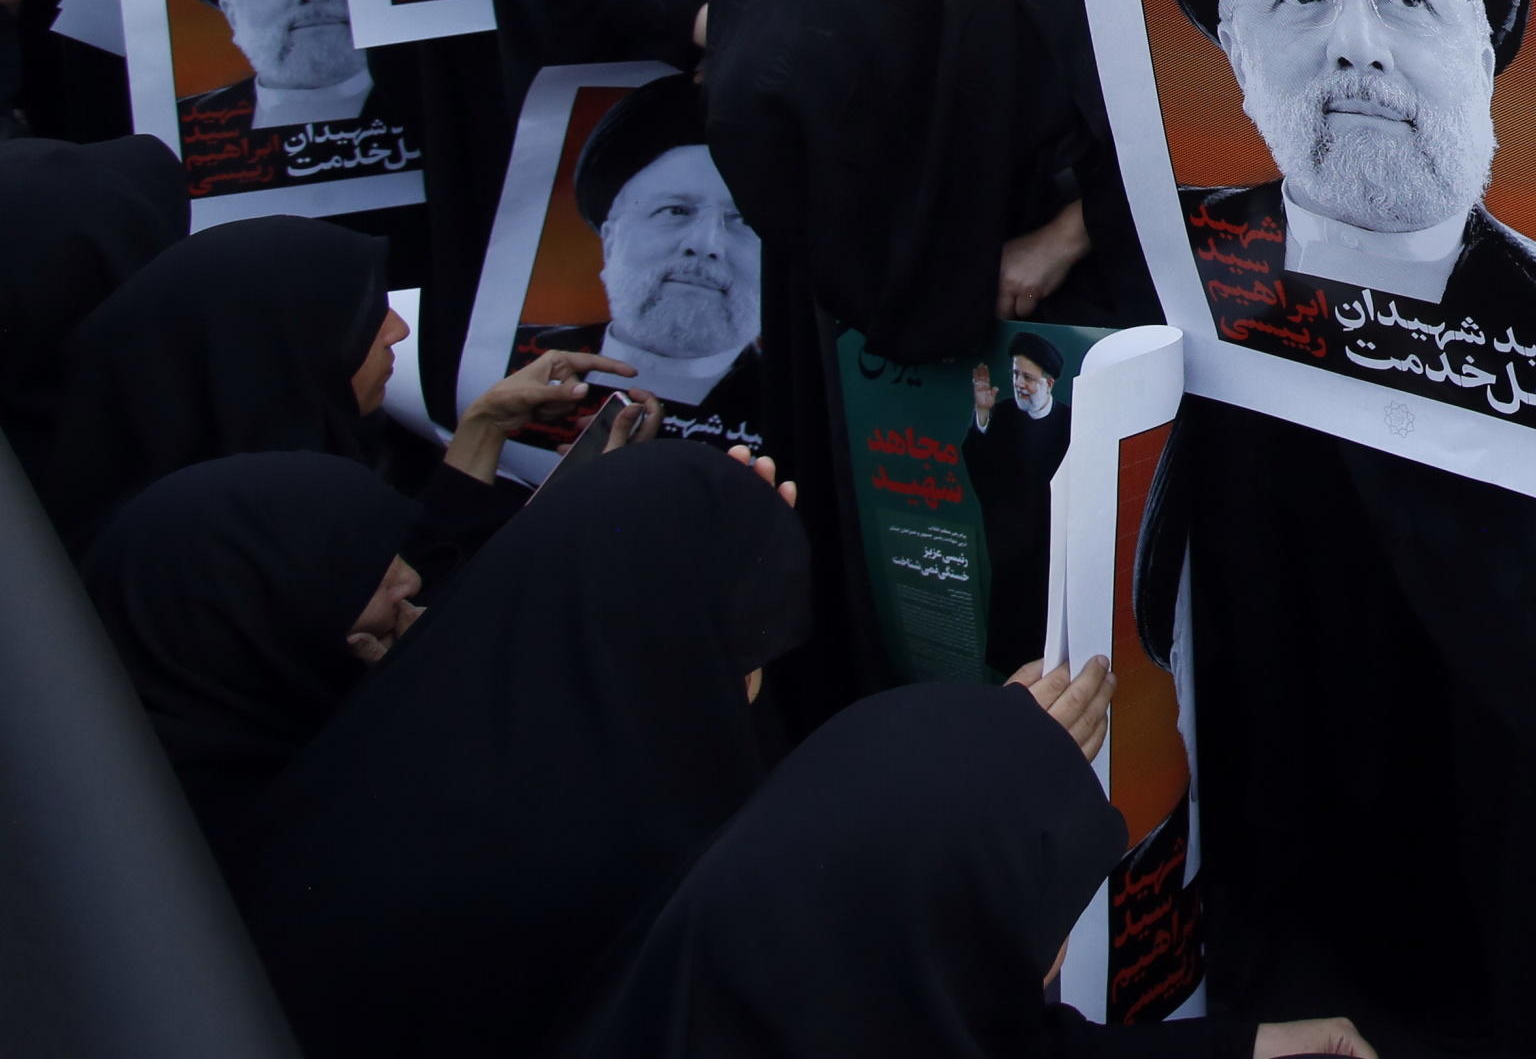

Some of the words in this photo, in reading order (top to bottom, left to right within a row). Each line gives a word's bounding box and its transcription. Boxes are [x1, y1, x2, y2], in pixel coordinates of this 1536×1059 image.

[287, 141, 392, 177] خدمت
[1190, 204, 1284, 245] شهید
[1197, 238, 1270, 275] سید
[1208, 274, 1330, 324] ابراهیم
[1344, 339, 1498, 390] خدمت
[662, 414, 723, 438] شهی
[867, 427, 960, 470] مجاهد
[871, 466, 964, 509] شهید
